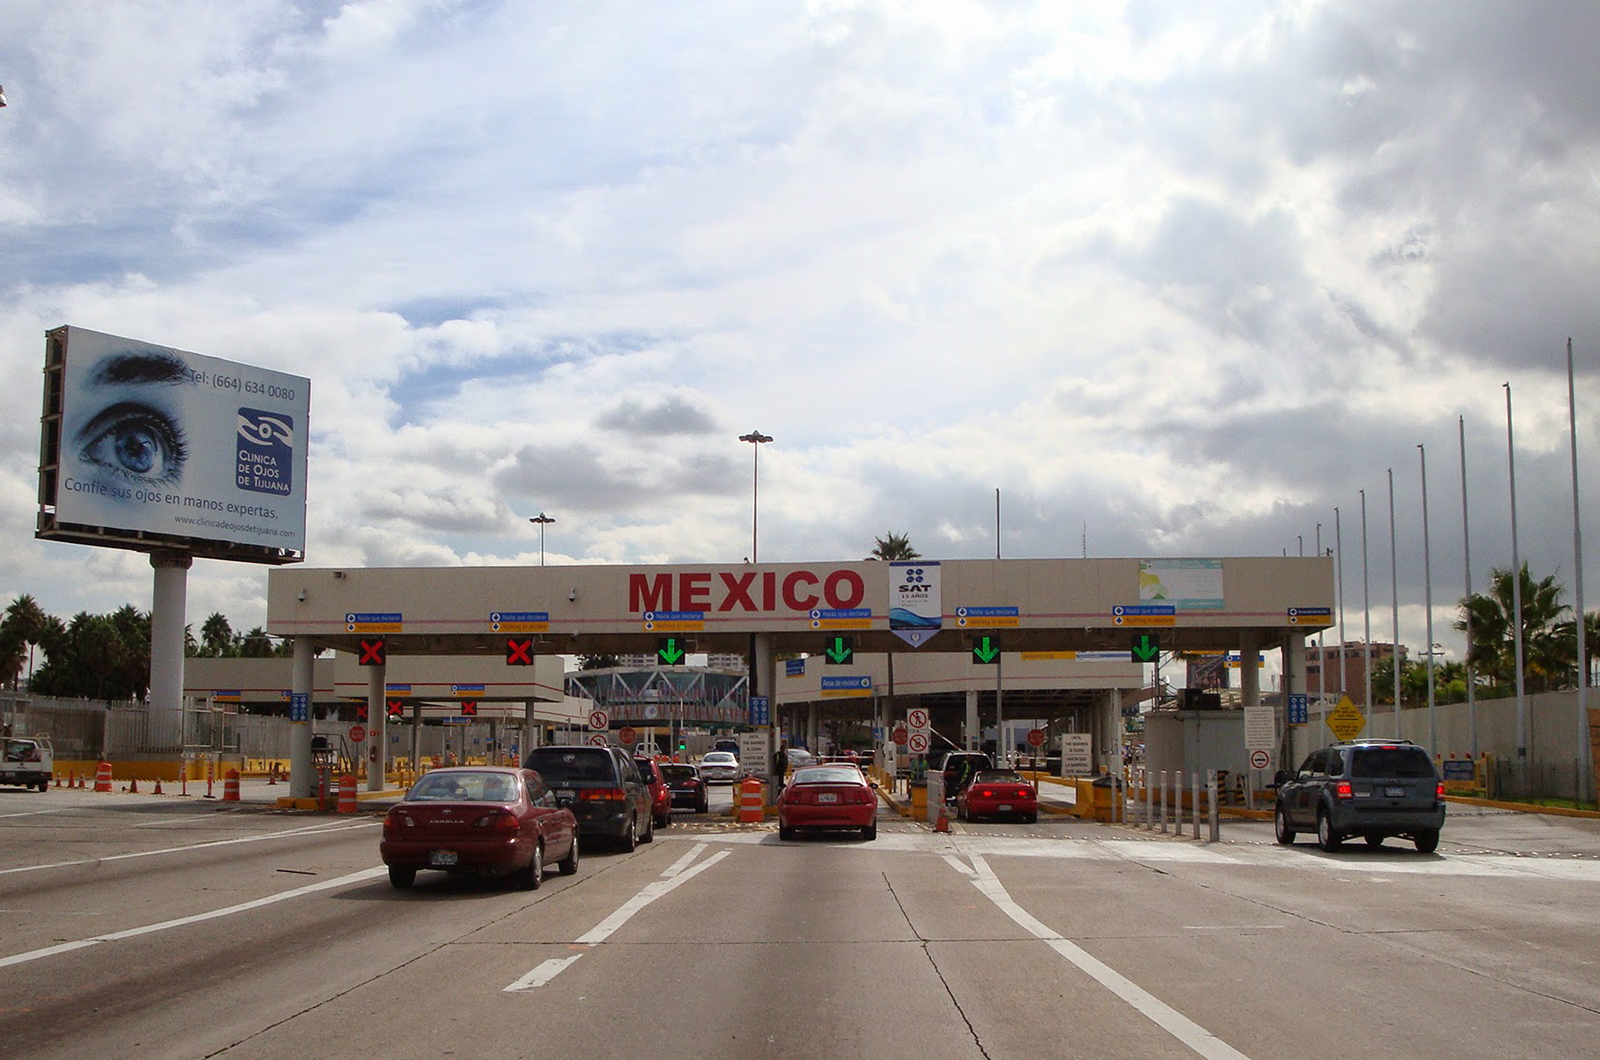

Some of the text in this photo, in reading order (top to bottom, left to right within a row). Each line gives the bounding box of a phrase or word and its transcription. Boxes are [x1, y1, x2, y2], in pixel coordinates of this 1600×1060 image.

[190, 369, 295, 401] Tel: (664) 634 0080
[238, 464, 250, 473] DE
[238, 476, 249, 486] DE
[111, 487, 132, 499] sus
[136, 488, 162, 504] ojos
[165, 494, 180, 505] en
[184, 498, 224, 511] manos
[227, 503, 279, 519] expertas.
[175, 516, 296, 538] www.clinicadeojosdetijuana.com
[629, 569, 865, 612] MEXICO
[898, 584, 931, 592] SAT
